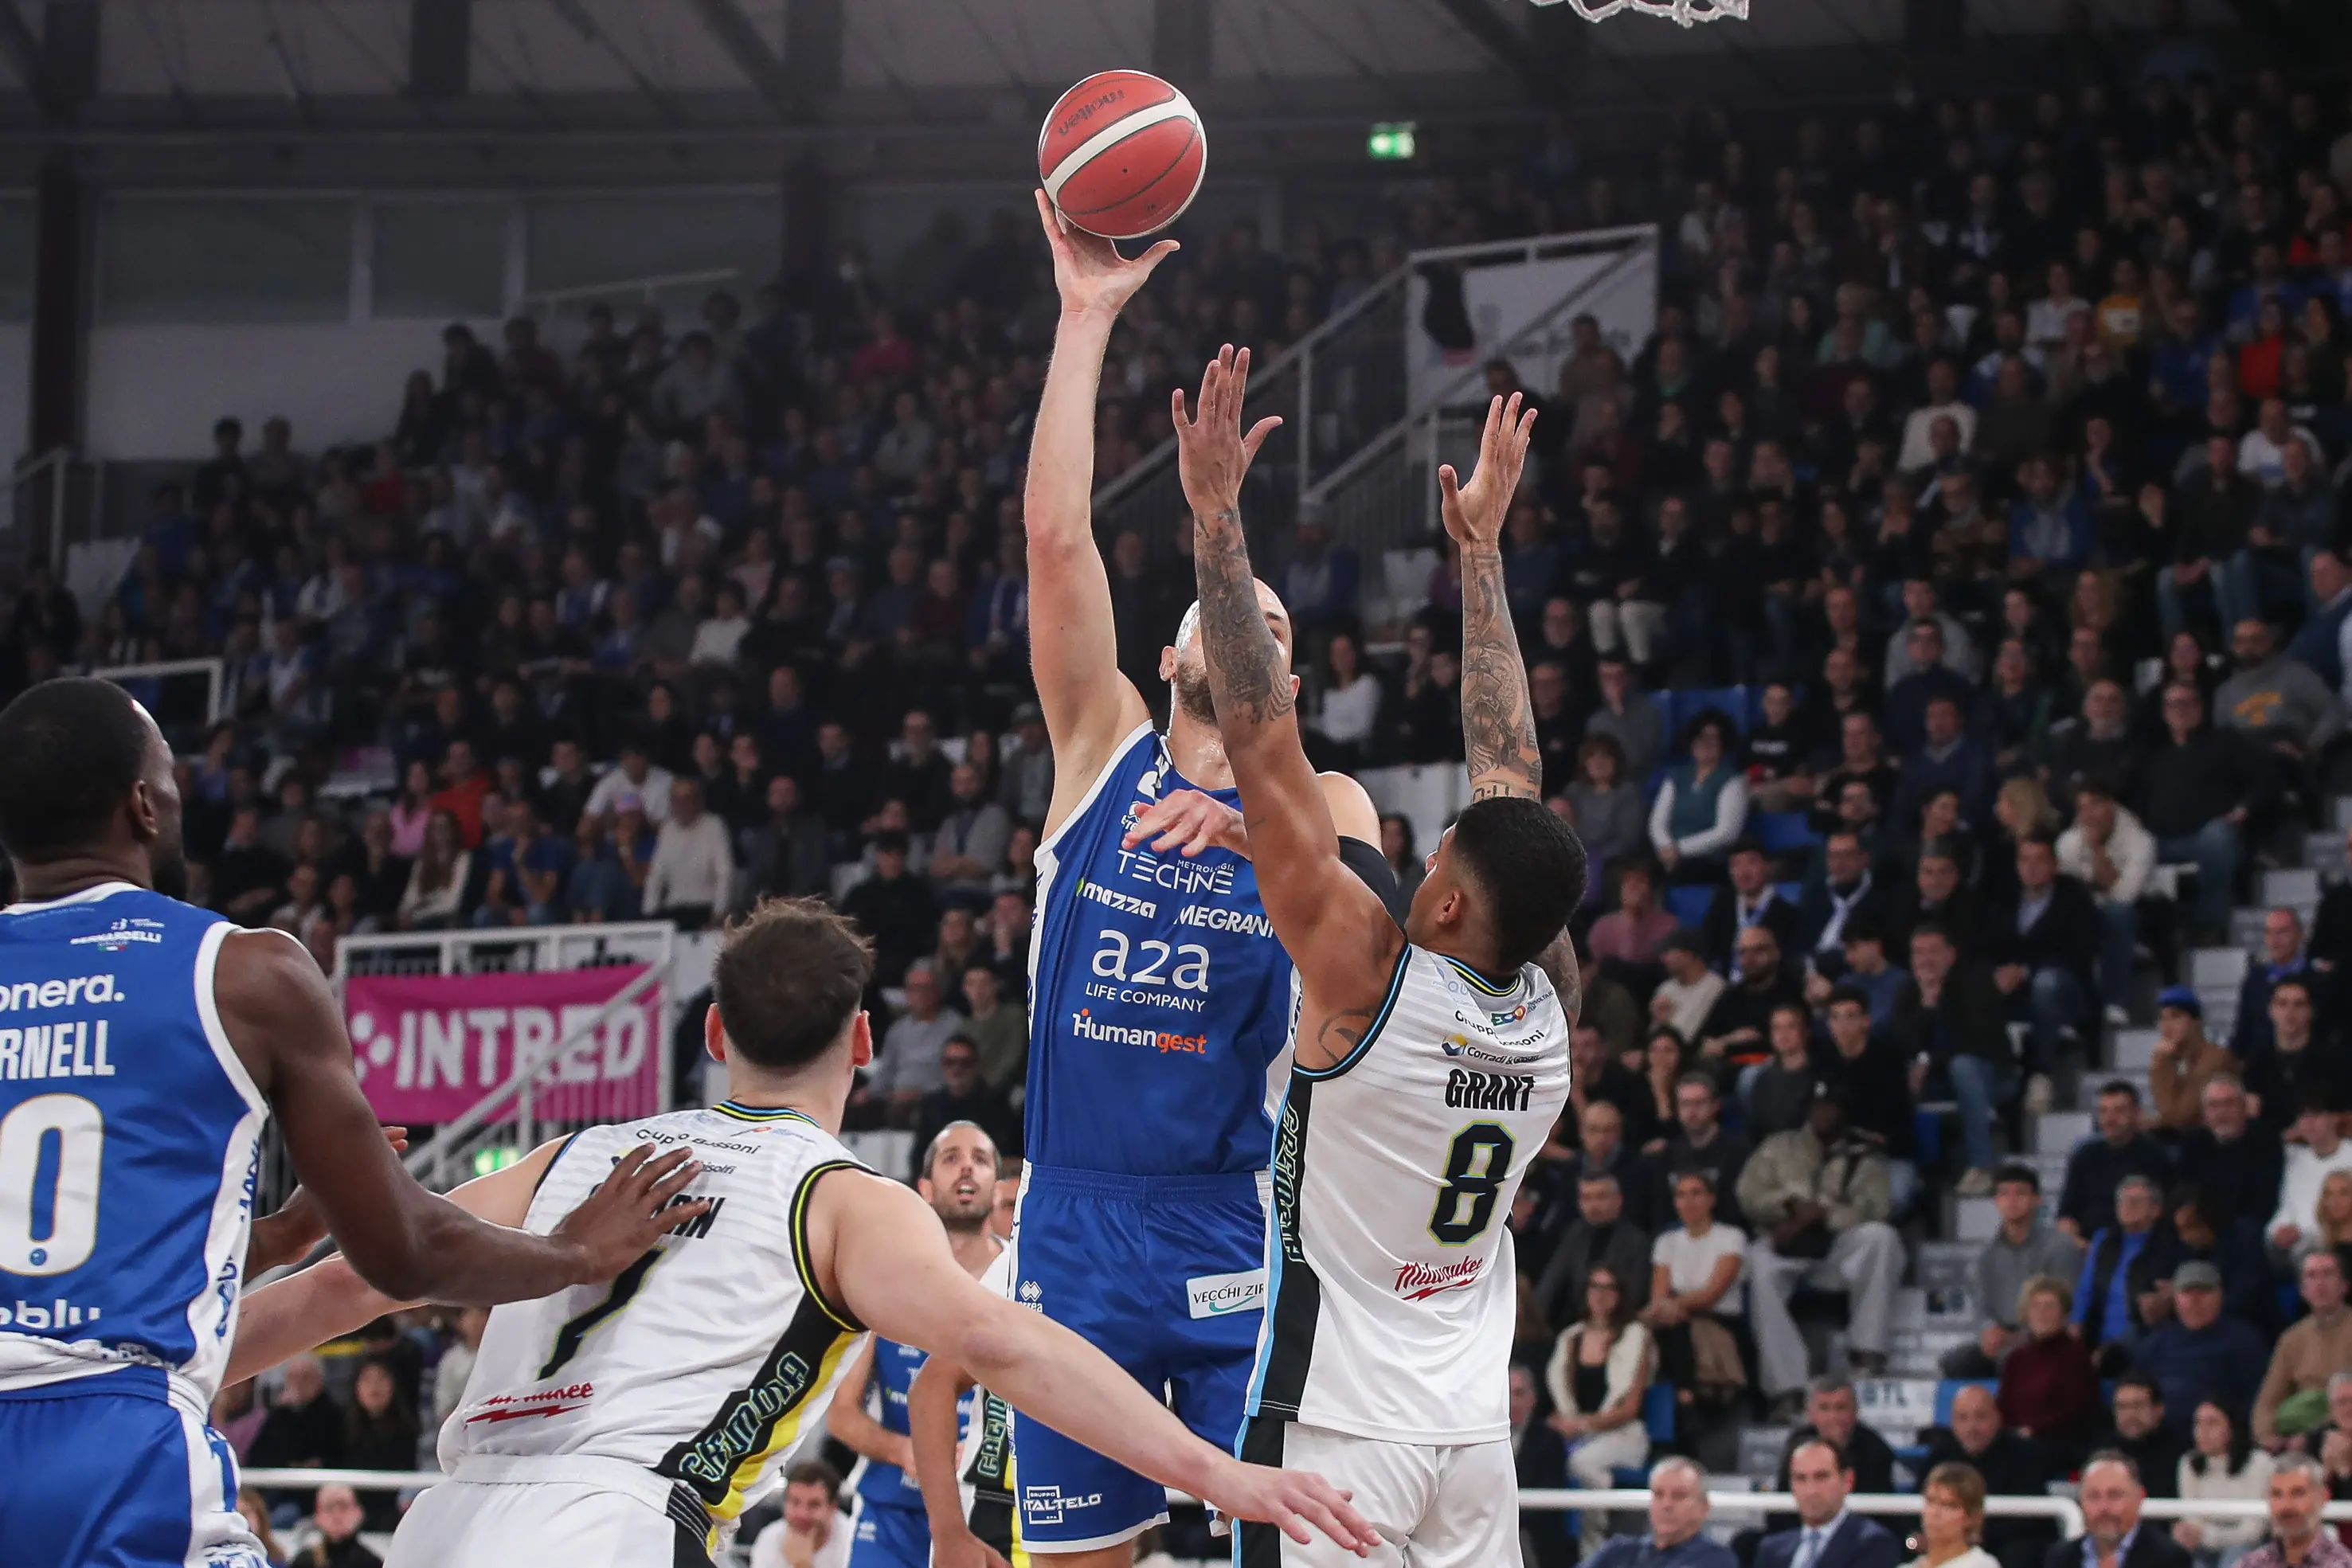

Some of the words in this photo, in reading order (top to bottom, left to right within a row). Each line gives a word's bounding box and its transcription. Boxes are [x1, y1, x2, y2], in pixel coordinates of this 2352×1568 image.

[1083, 882, 1157, 919] mazza
[1092, 929, 1210, 993] a2a
[1085, 982, 1117, 1000] LIFE
[1120, 989, 1206, 1013] COMPANY
[0, 1019, 115, 1081] RNELL
[393, 1006, 648, 1089] INTRED
[1072, 1009, 1207, 1054] Humangest
[1467, 1046, 1505, 1064] Corradi
[1445, 1069, 1535, 1111] GRANT
[0, 1093, 104, 1275] 0
[1426, 1120, 1517, 1247] 8
[1194, 1286, 1241, 1304] VECCHI
[1245, 1283, 1264, 1296] ZIR
[1392, 1255, 1483, 1292] Milwaukee
[1023, 1493, 1102, 1511] ITALTELO
